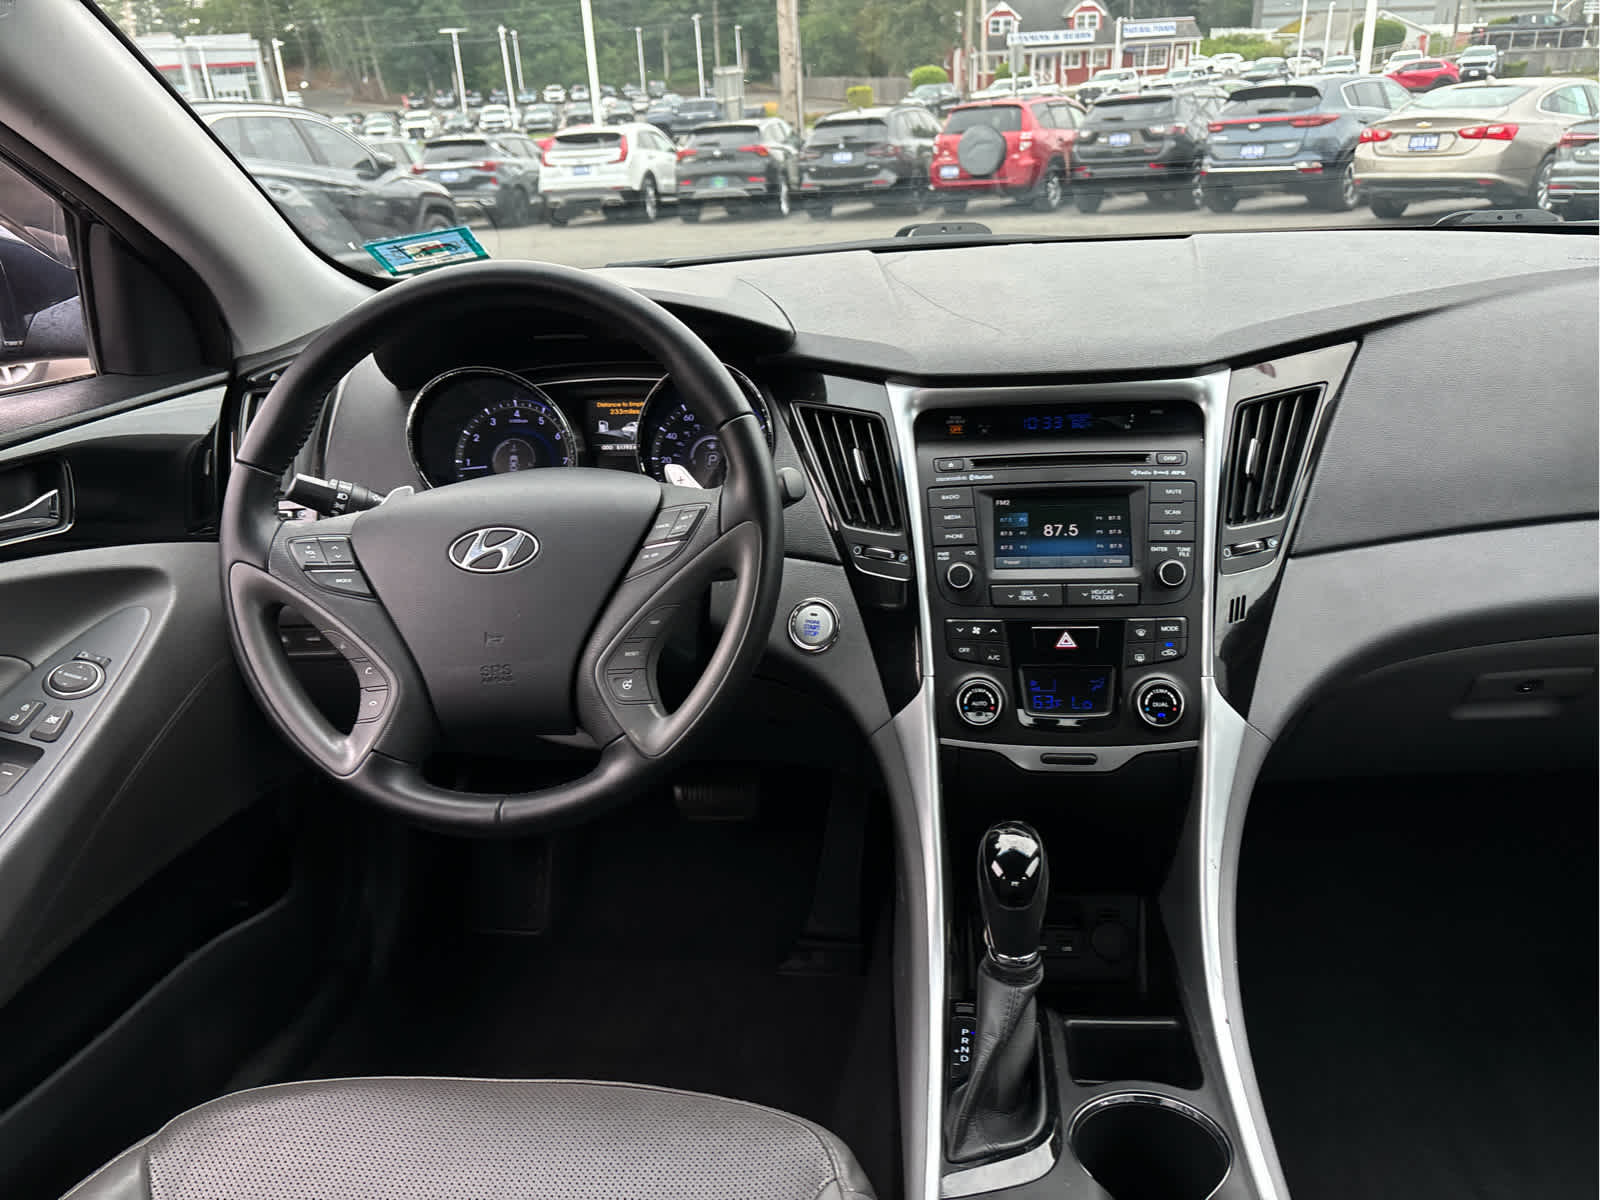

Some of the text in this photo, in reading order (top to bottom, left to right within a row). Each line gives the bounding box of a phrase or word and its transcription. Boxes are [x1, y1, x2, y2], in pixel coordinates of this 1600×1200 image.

[683, 413, 695, 422] 60
[1042, 523, 1079, 537] 87.5
[961, 1028, 969, 1036] P
[961, 1037, 969, 1045] R
[960, 1055, 969, 1063] D
